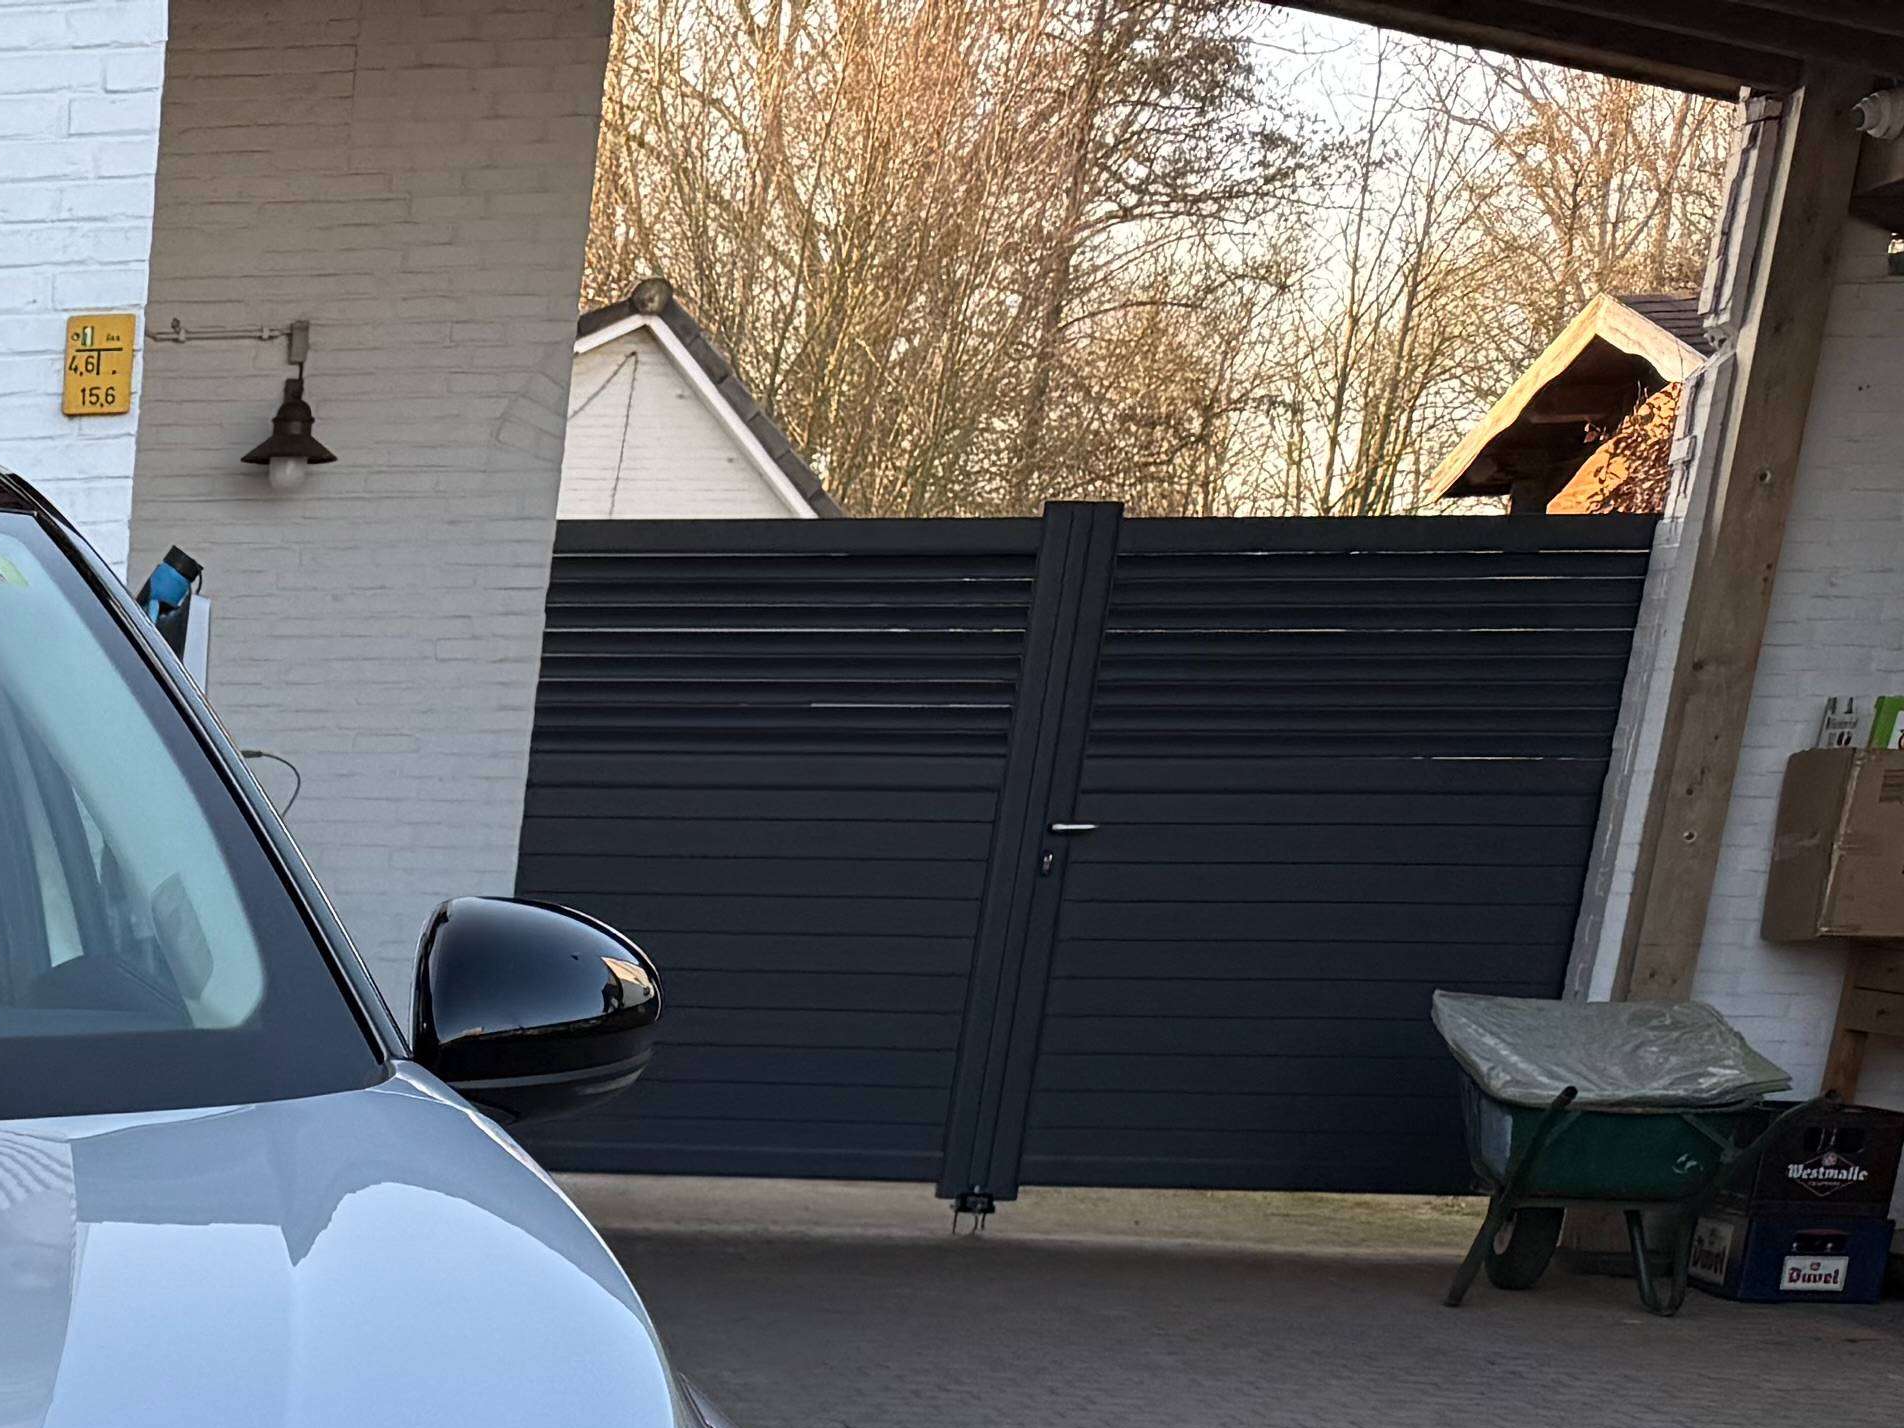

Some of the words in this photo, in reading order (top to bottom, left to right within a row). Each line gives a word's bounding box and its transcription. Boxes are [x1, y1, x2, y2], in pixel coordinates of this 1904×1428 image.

[68, 355, 95, 377] 4,6
[80, 386, 116, 407] 15,6
[1787, 1163, 1868, 1181] Westmalle
[1787, 1267, 1840, 1285] Duvel
